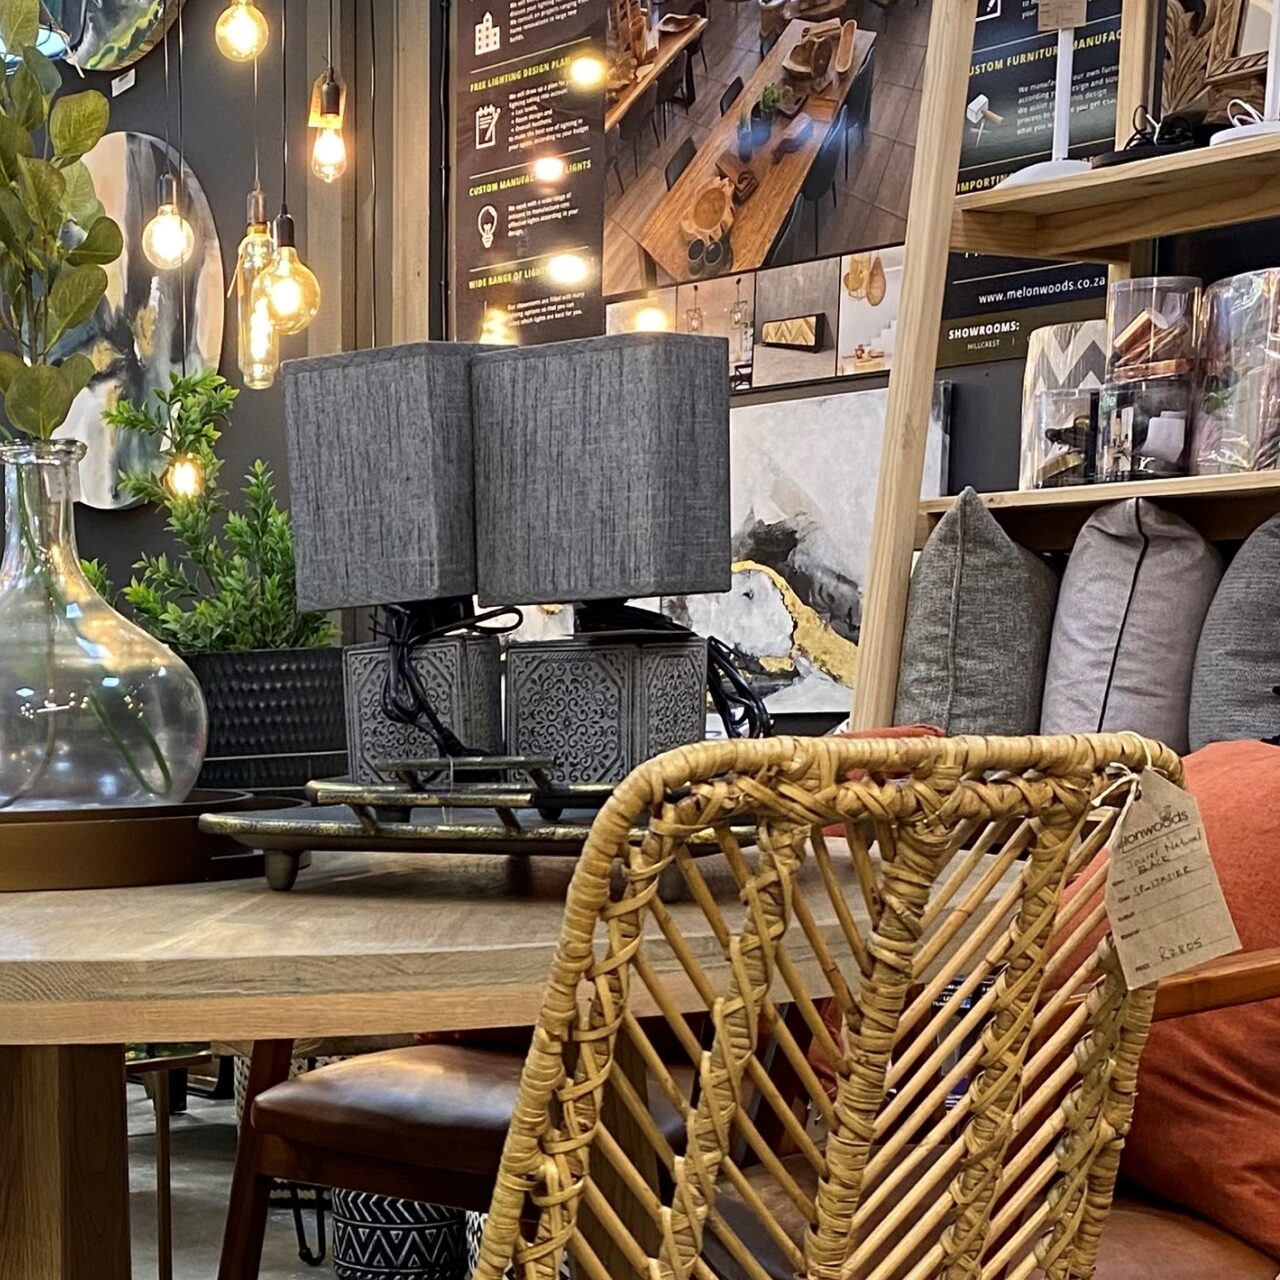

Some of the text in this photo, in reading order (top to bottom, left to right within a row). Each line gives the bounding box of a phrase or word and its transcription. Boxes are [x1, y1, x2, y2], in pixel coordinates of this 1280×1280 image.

[969, 30, 1122, 76] USTOM FURNITUR MANUFAC
[488, 71, 522, 88] LIGHTING
[523, 63, 550, 78] DESIGN
[468, 182, 499, 197] CUSTOM
[565, 160, 592, 174] LIGHTS
[957, 172, 1013, 192] IMPORTIN
[468, 278, 486, 289] WIDE
[488, 272, 512, 283] RANGE
[513, 270, 522, 280] OF
[978, 276, 1106, 304] www.melonwoods.co.za
[948, 320, 1020, 340] SHOWROOMS:
